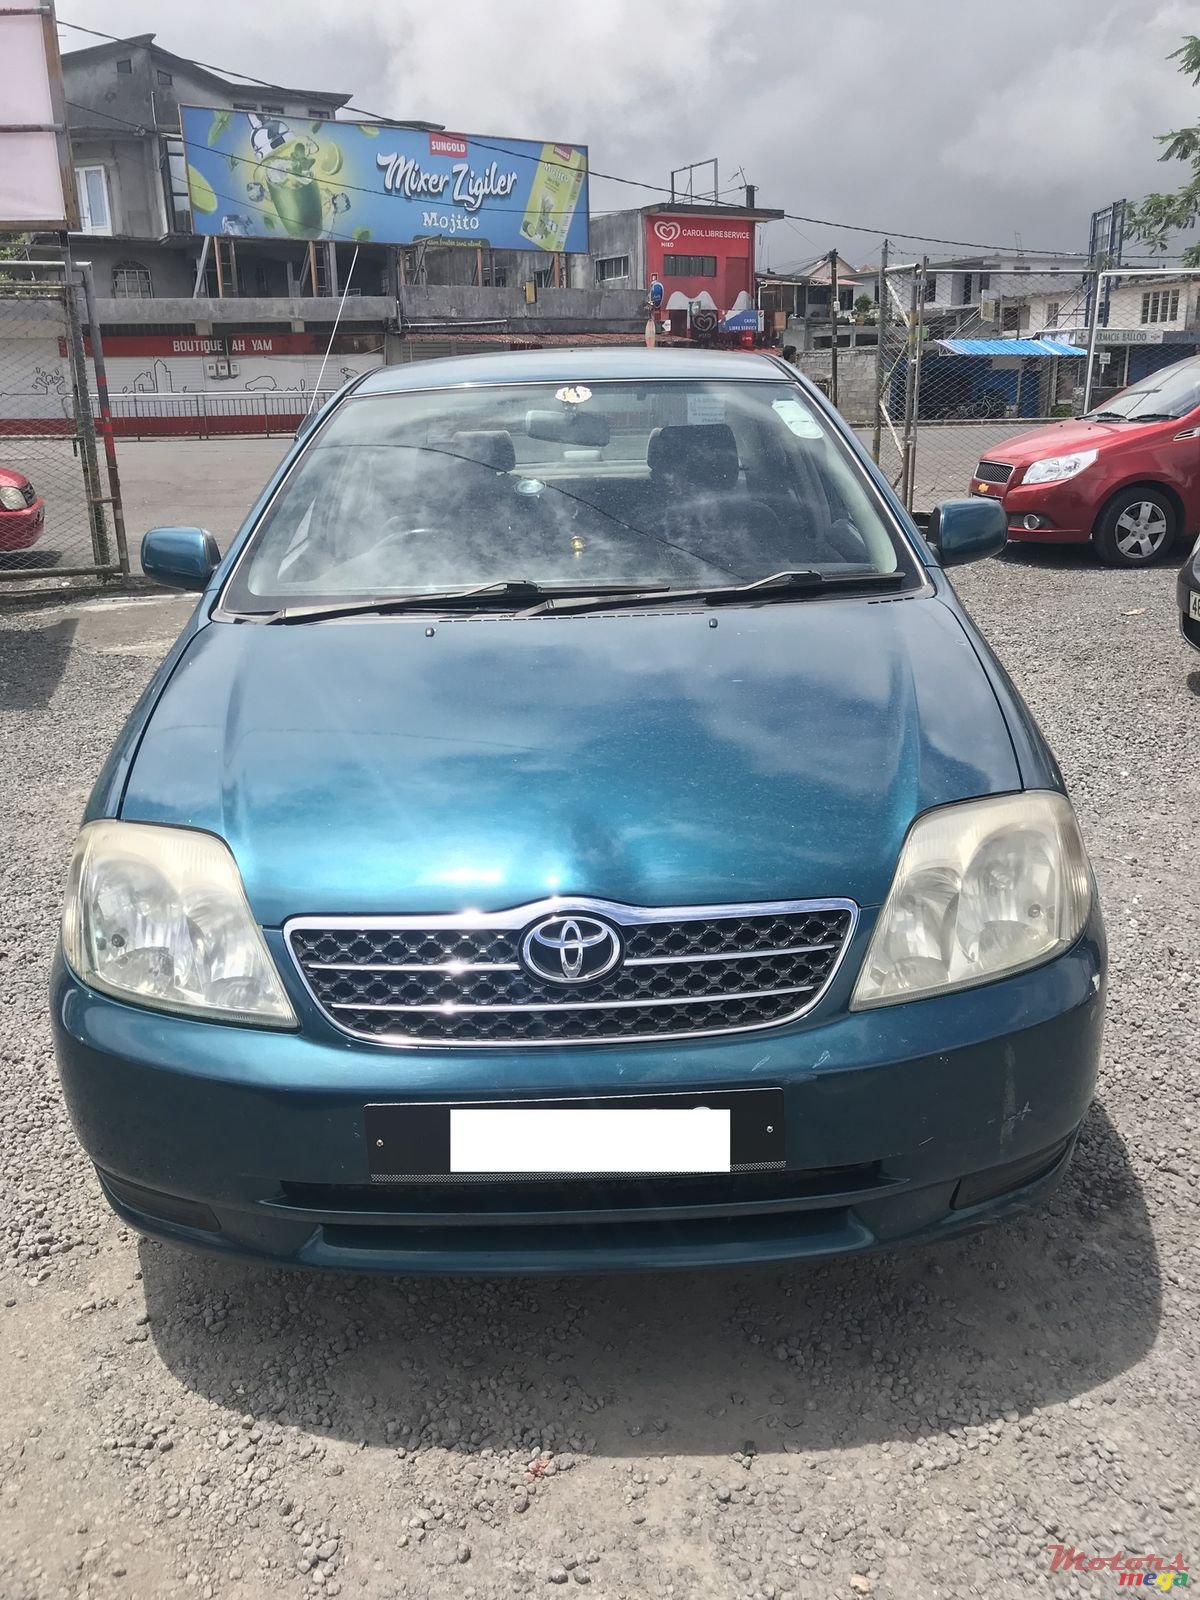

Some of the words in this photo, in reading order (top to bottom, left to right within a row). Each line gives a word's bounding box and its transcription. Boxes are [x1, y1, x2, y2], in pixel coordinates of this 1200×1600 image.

[431, 140, 466, 153] SUNGOLD
[376, 152, 449, 196] Mixer
[452, 160, 517, 211] Zigiler
[422, 211, 480, 233] Mojito
[172, 340, 223, 354] BOUTIQUE
[231, 339, 246, 351] AH
[251, 338, 273, 351] YAM
